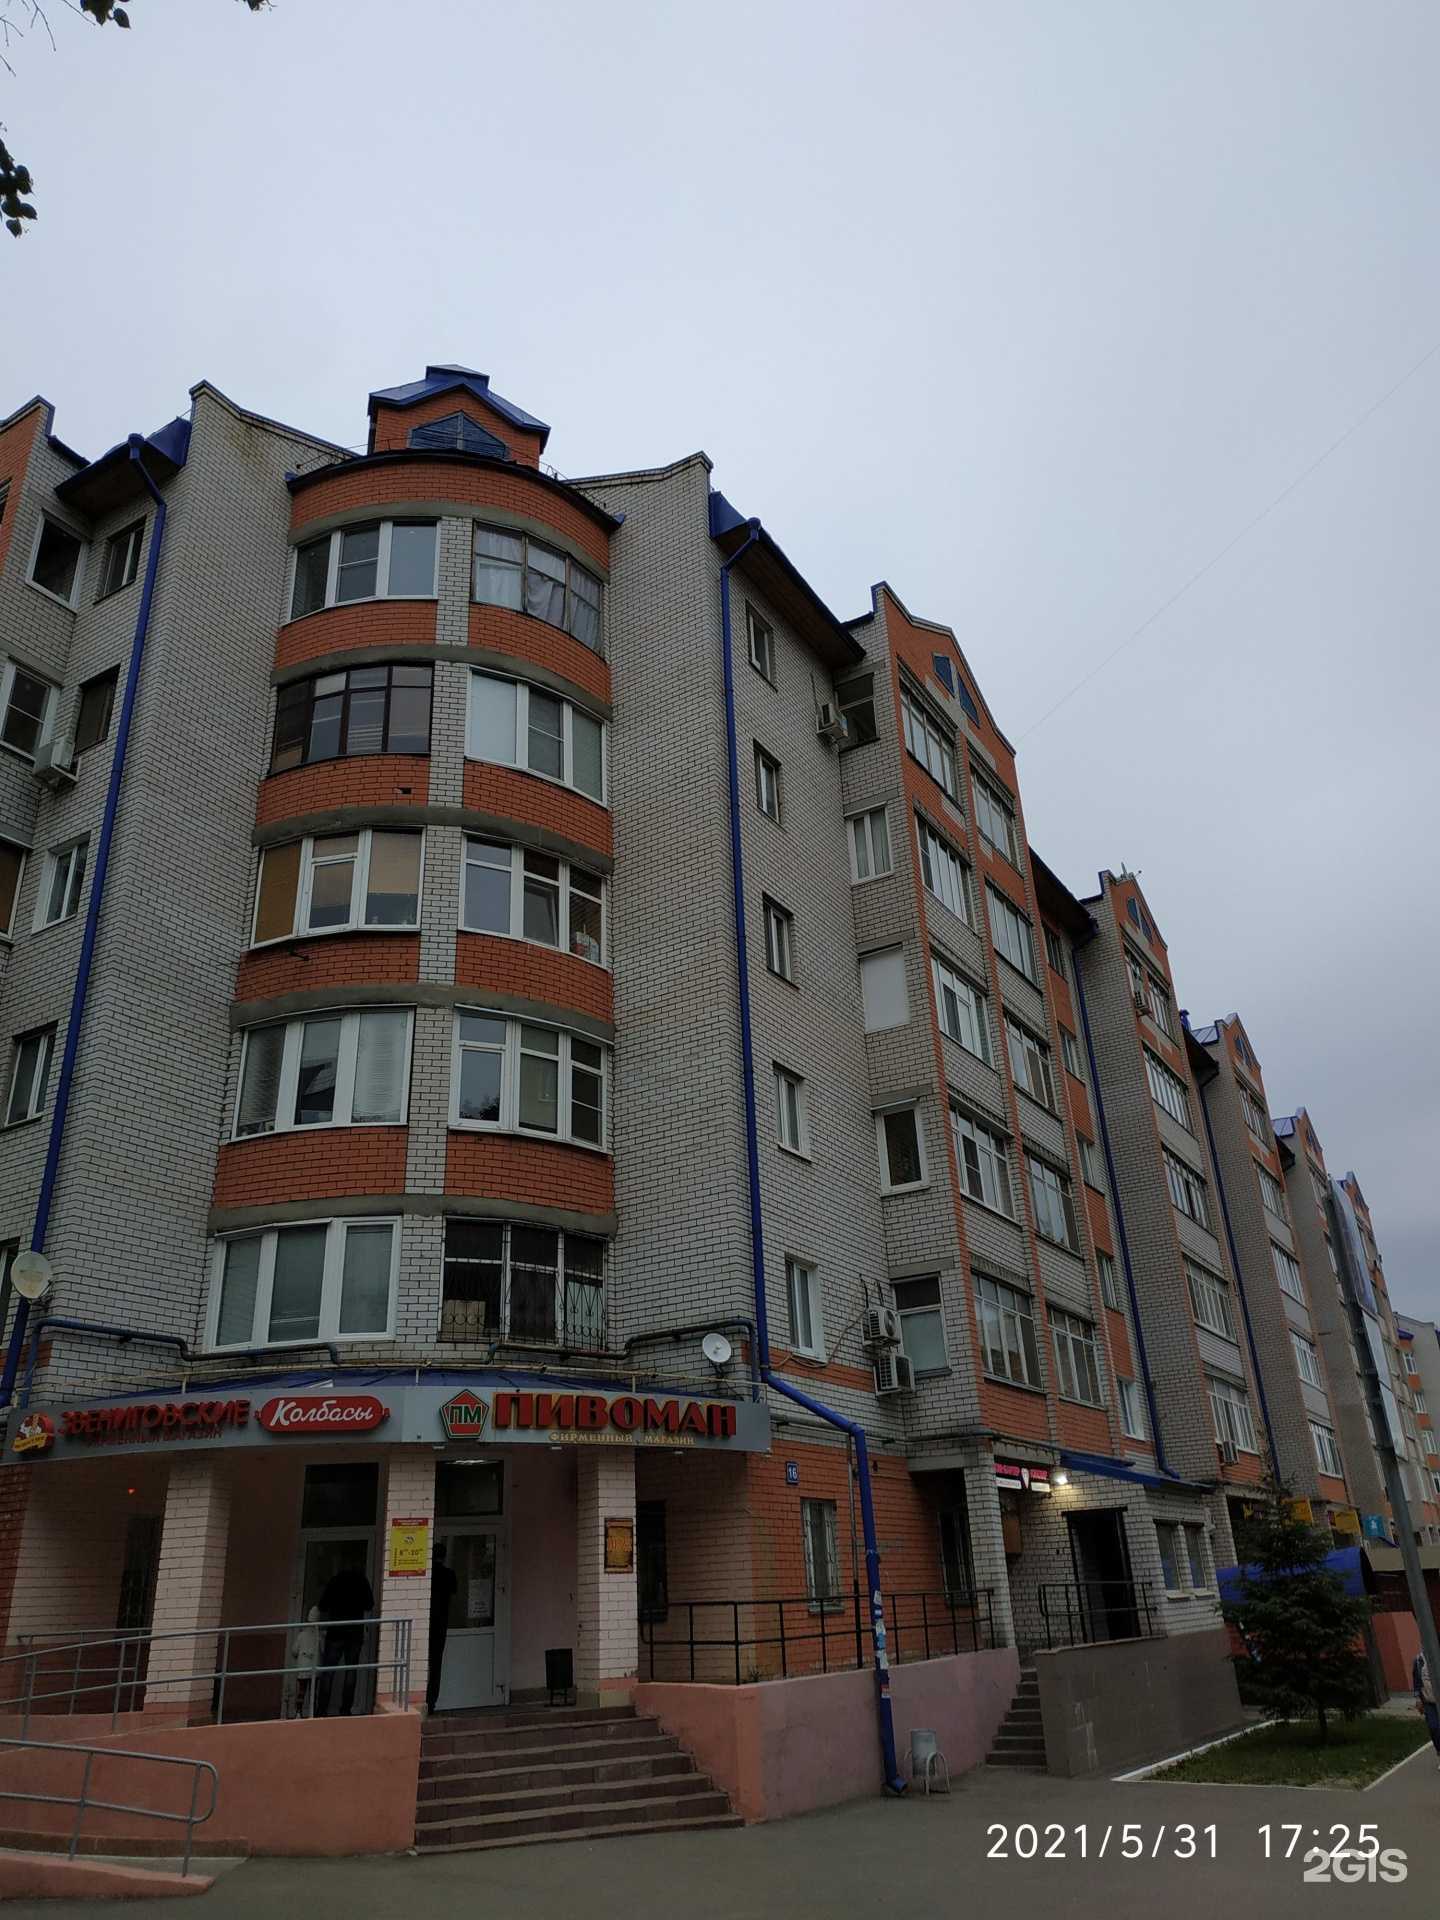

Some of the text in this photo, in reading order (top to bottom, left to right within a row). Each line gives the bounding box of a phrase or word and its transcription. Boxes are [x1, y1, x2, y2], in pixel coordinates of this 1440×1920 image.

[59, 1400, 250, 1436] ЗВЕНИГОВСКИЕ
[269, 1399, 374, 1427] Колбасы
[449, 1403, 483, 1425] ПМ
[495, 1393, 737, 1437] ПИВОМАН
[550, 1431, 696, 1446] ФИРМЕННЫЙ МАГАЗИН
